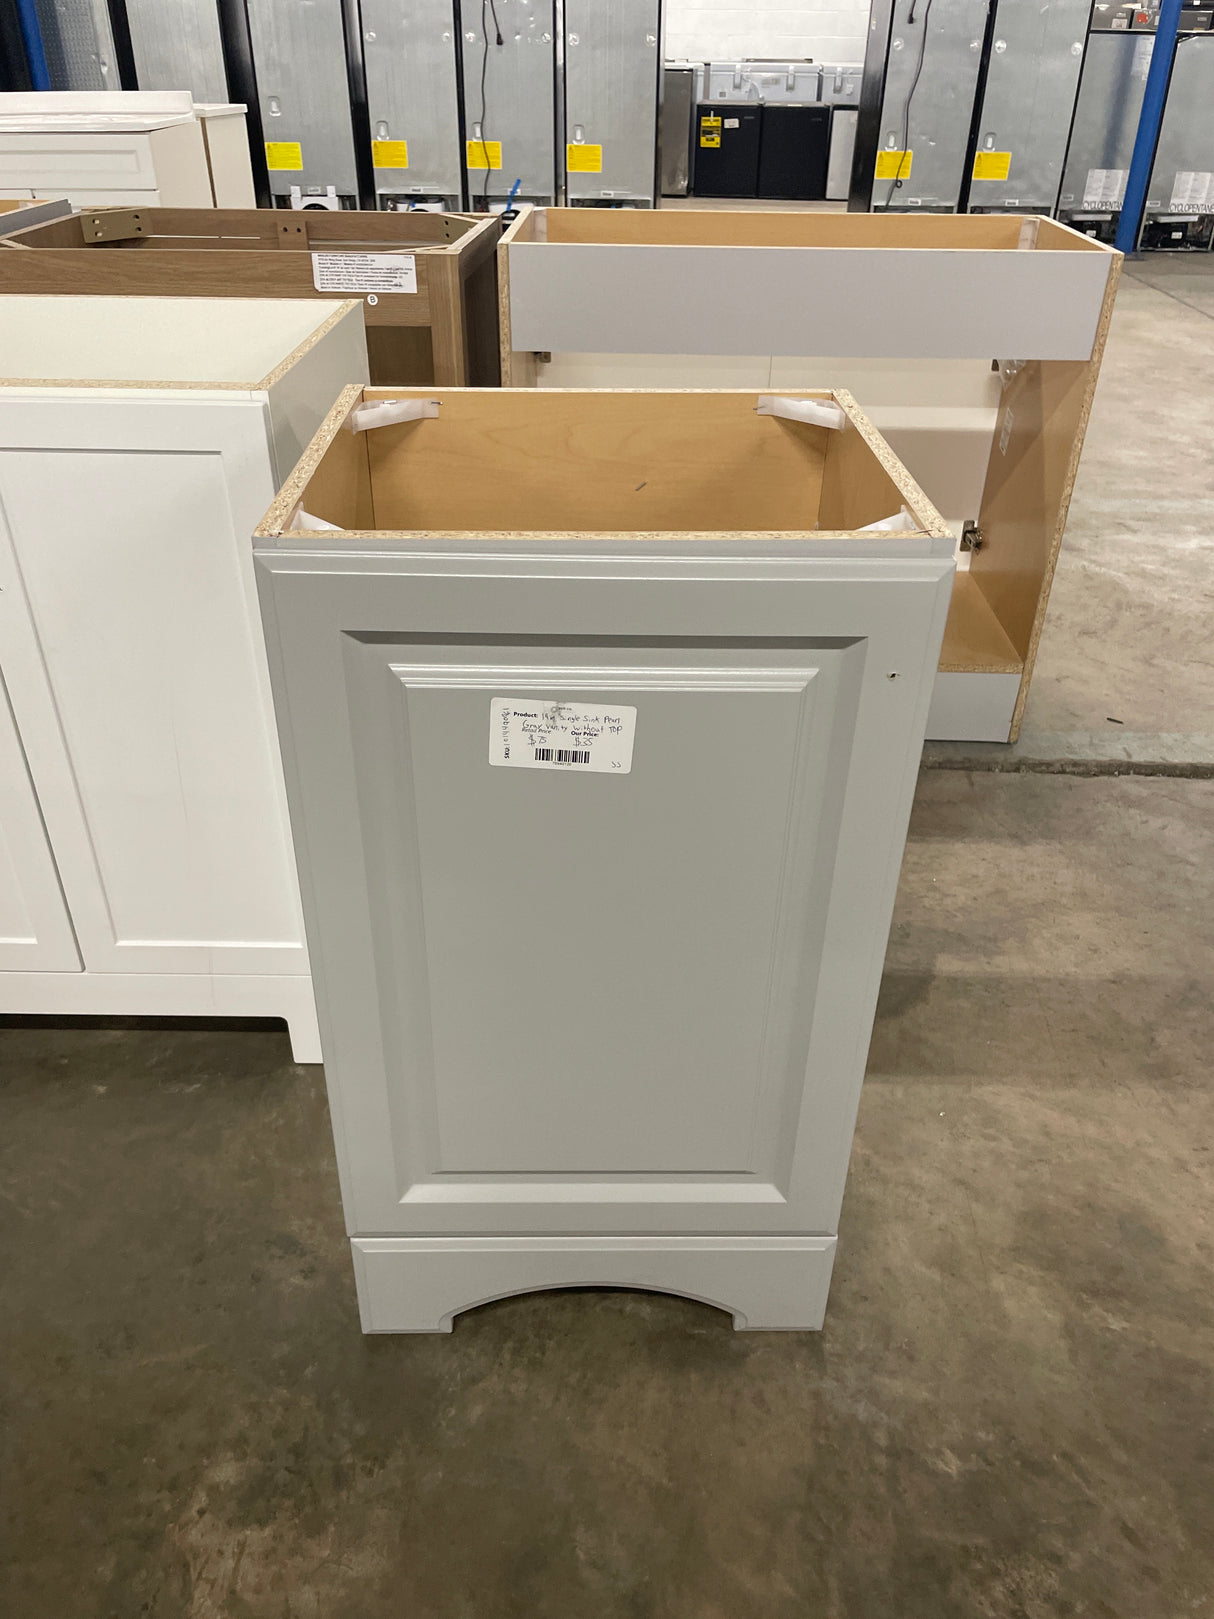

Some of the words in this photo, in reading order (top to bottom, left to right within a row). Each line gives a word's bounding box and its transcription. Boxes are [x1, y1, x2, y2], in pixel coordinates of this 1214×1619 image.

[559, 715, 580, 723] Single
[583, 715, 600, 723] Sink
[522, 720, 543, 729] Gray
